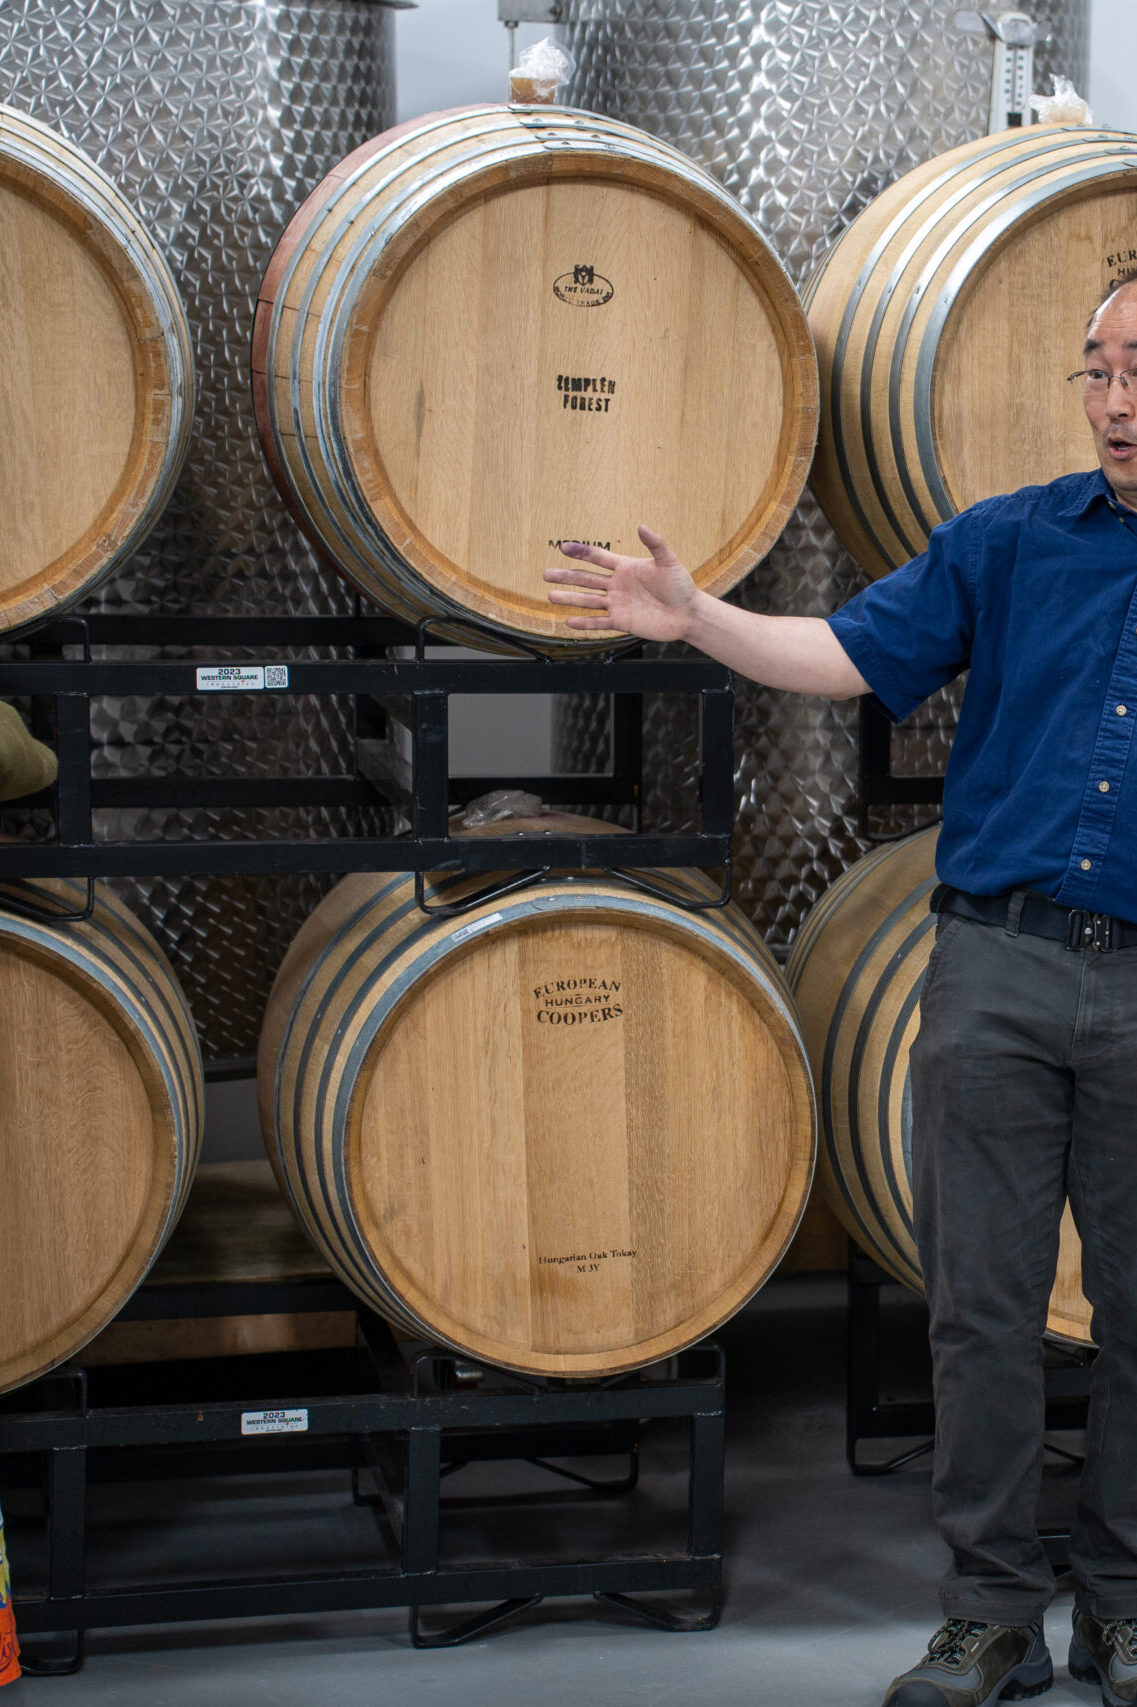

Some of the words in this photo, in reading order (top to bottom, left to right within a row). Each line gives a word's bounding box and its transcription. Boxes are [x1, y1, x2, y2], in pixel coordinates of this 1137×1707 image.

[563, 394, 611, 412] FOREST
[533, 978, 621, 999] EUROPEAN
[545, 994, 610, 1008] HUNGARY
[536, 1003, 623, 1026] COOPERS
[538, 1253, 587, 1265] Hungarian
[589, 1251, 608, 1260] Oak
[610, 1248, 638, 1259] Tokay
[576, 1264, 586, 1274] M
[588, 1263, 600, 1273] 3Y
[246, 1418, 277, 1426] WESTERN
[263, 1411, 286, 1419] 2023
